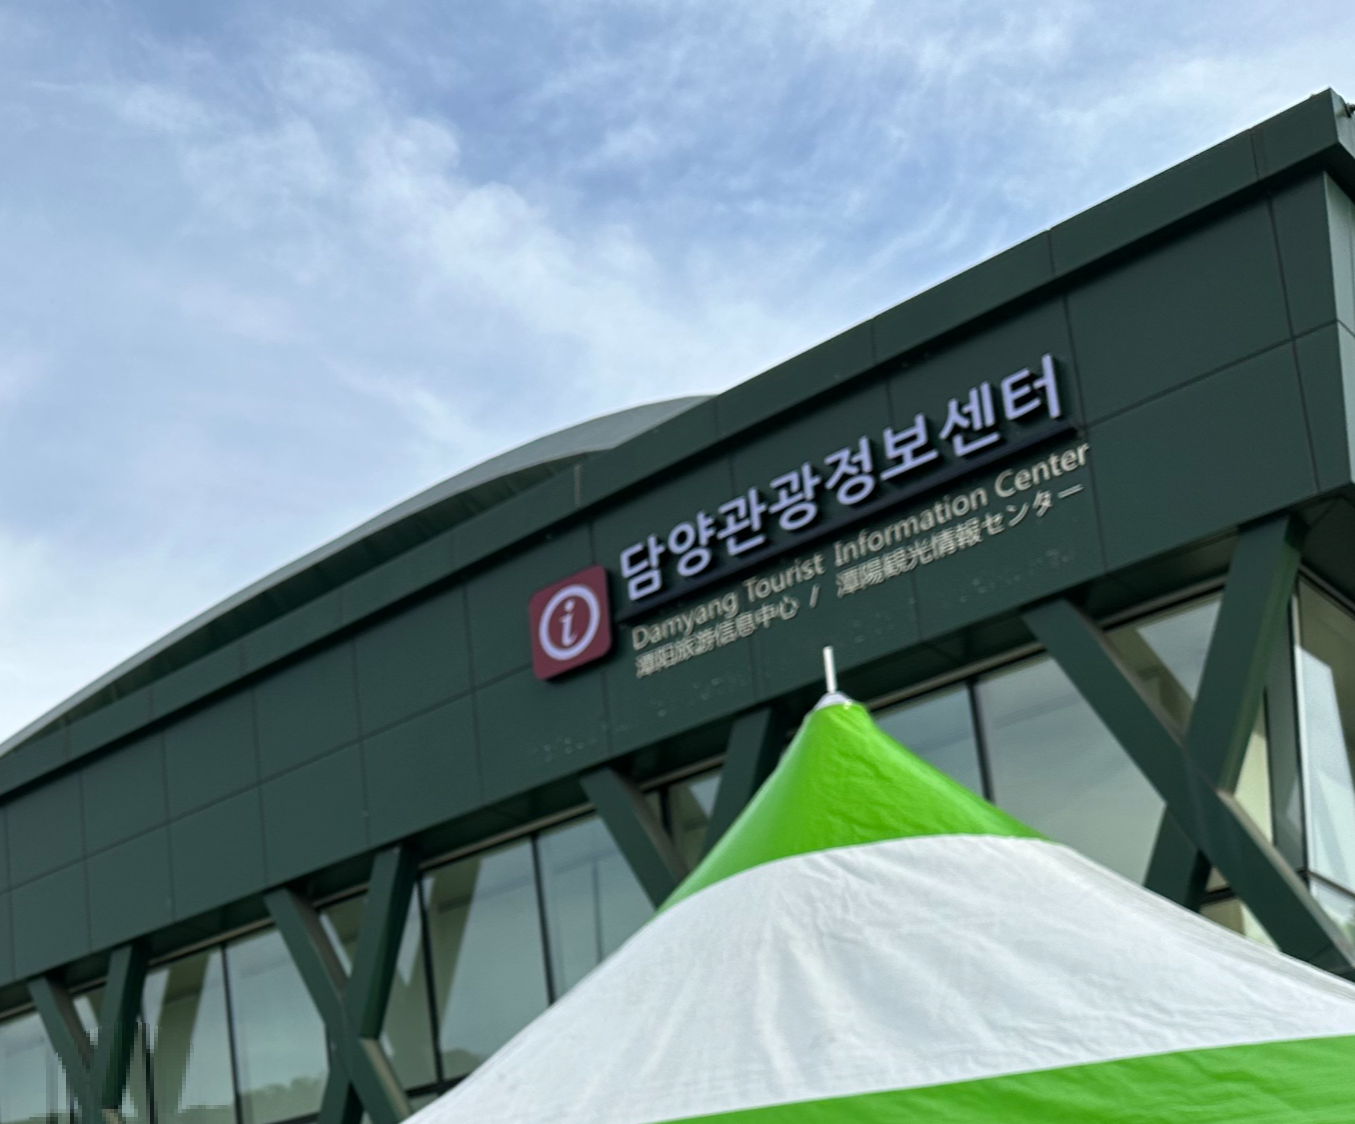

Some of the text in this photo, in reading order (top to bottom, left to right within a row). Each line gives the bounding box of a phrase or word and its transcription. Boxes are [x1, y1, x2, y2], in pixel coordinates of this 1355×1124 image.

[620, 353, 1062, 600] 담양관광정보센터
[632, 443, 1090, 651] Damyang Tourist Information Center
